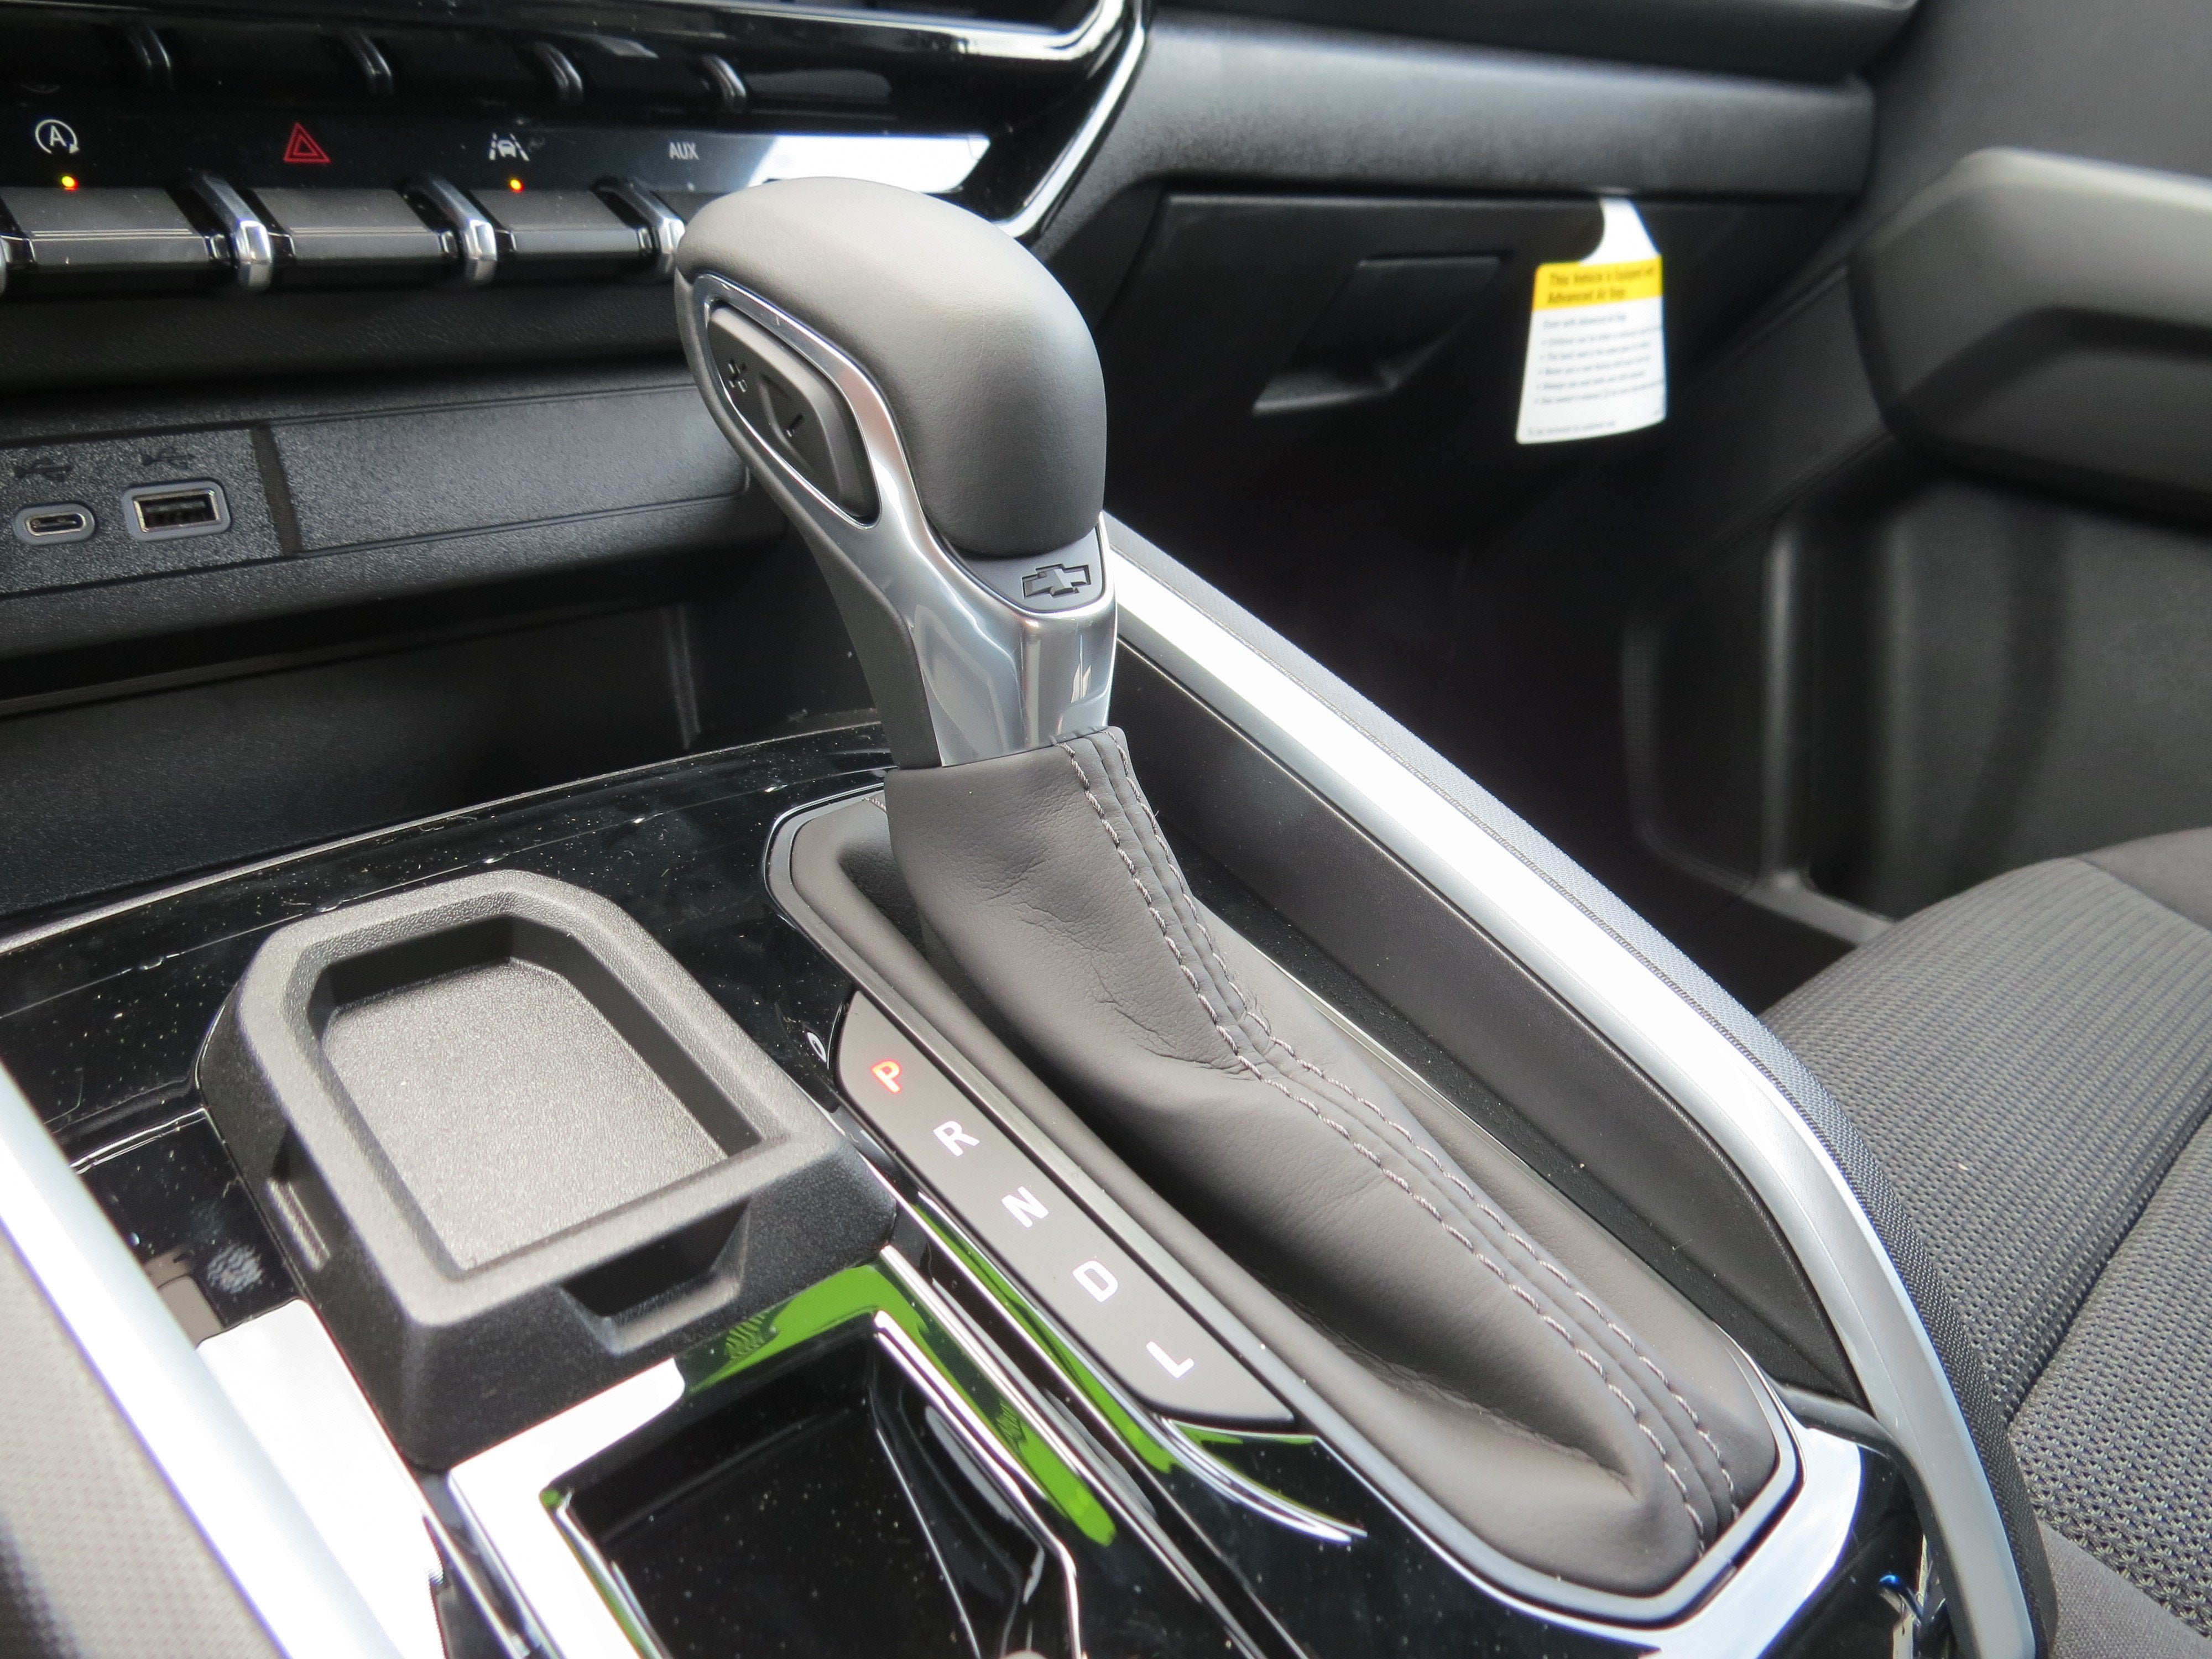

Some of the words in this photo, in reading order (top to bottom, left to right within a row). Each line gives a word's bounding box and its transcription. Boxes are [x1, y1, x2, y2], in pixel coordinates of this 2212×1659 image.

[49, 125, 67, 147] A
[669, 142, 700, 161] AUX
[870, 1059, 901, 1093] P
[933, 1120, 980, 1157] R
[1001, 1186, 1050, 1229] N
[1072, 1260, 1119, 1303] D
[1146, 1341, 1195, 1379] L
